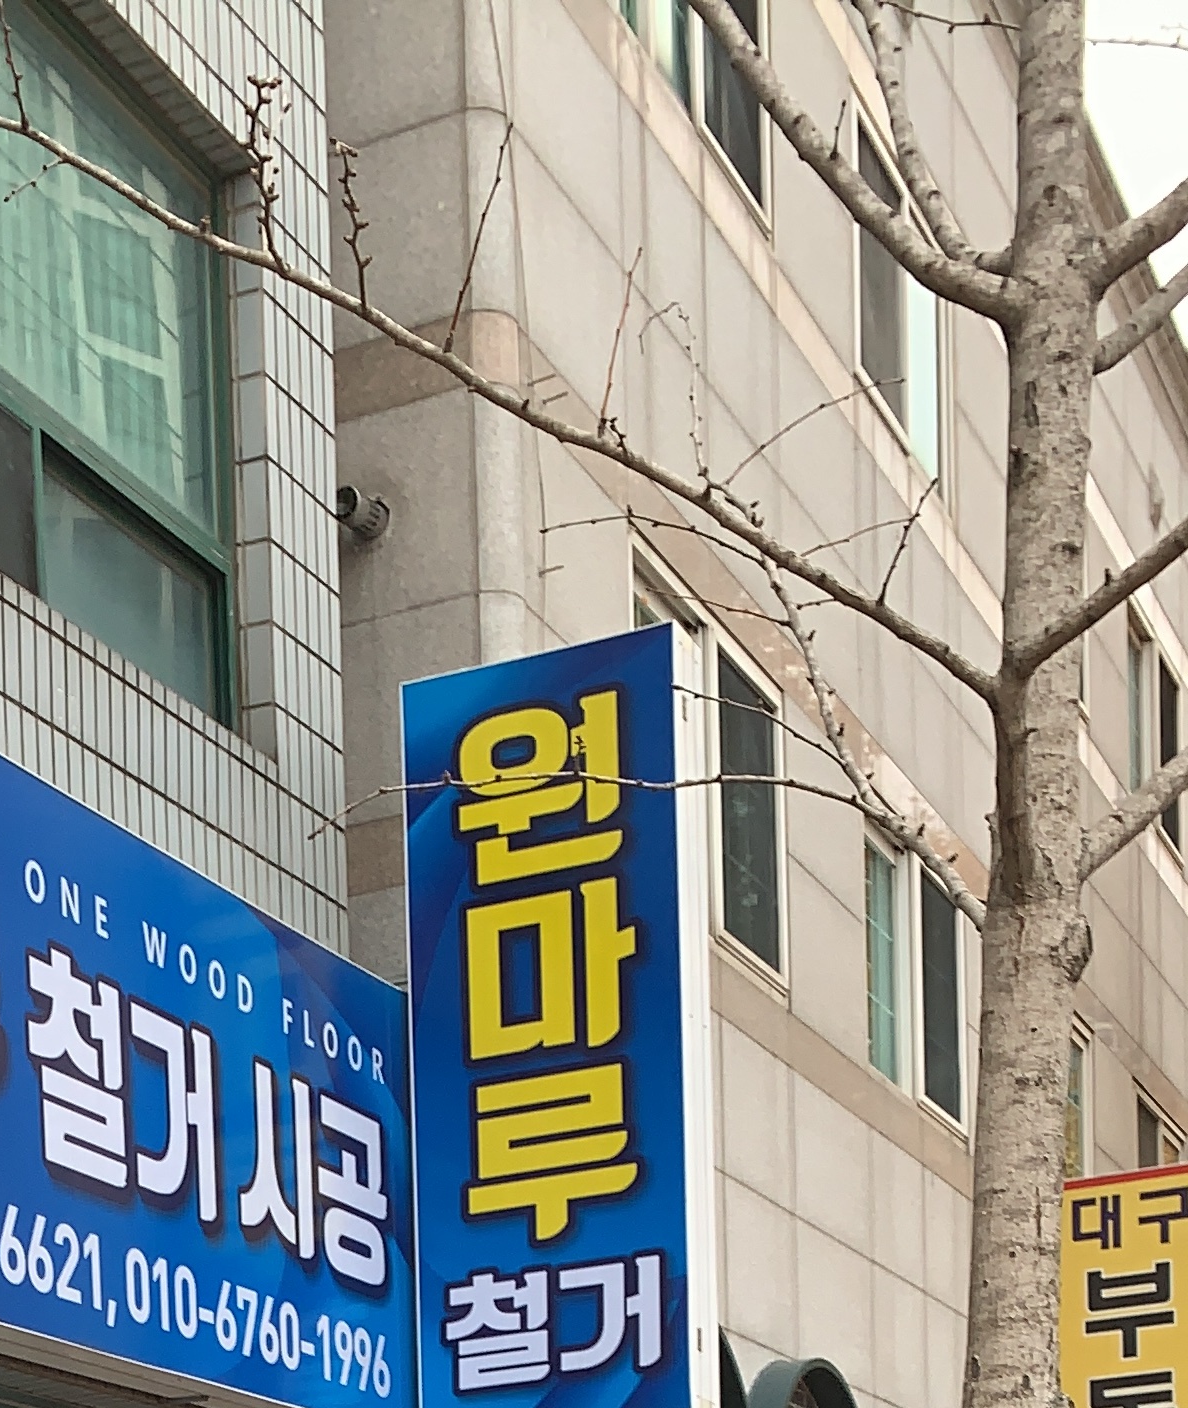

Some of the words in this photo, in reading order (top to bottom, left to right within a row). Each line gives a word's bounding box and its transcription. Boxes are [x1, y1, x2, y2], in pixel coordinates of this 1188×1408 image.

[24, 859, 110, 941] ONE
[142, 920, 254, 1015] WOOD
[282, 997, 386, 1086] FLOOR
[458, 689, 639, 1242] 원마루
[1071, 1185, 1188, 1252] 대구
[445, 1254, 662, 1392] 철거
